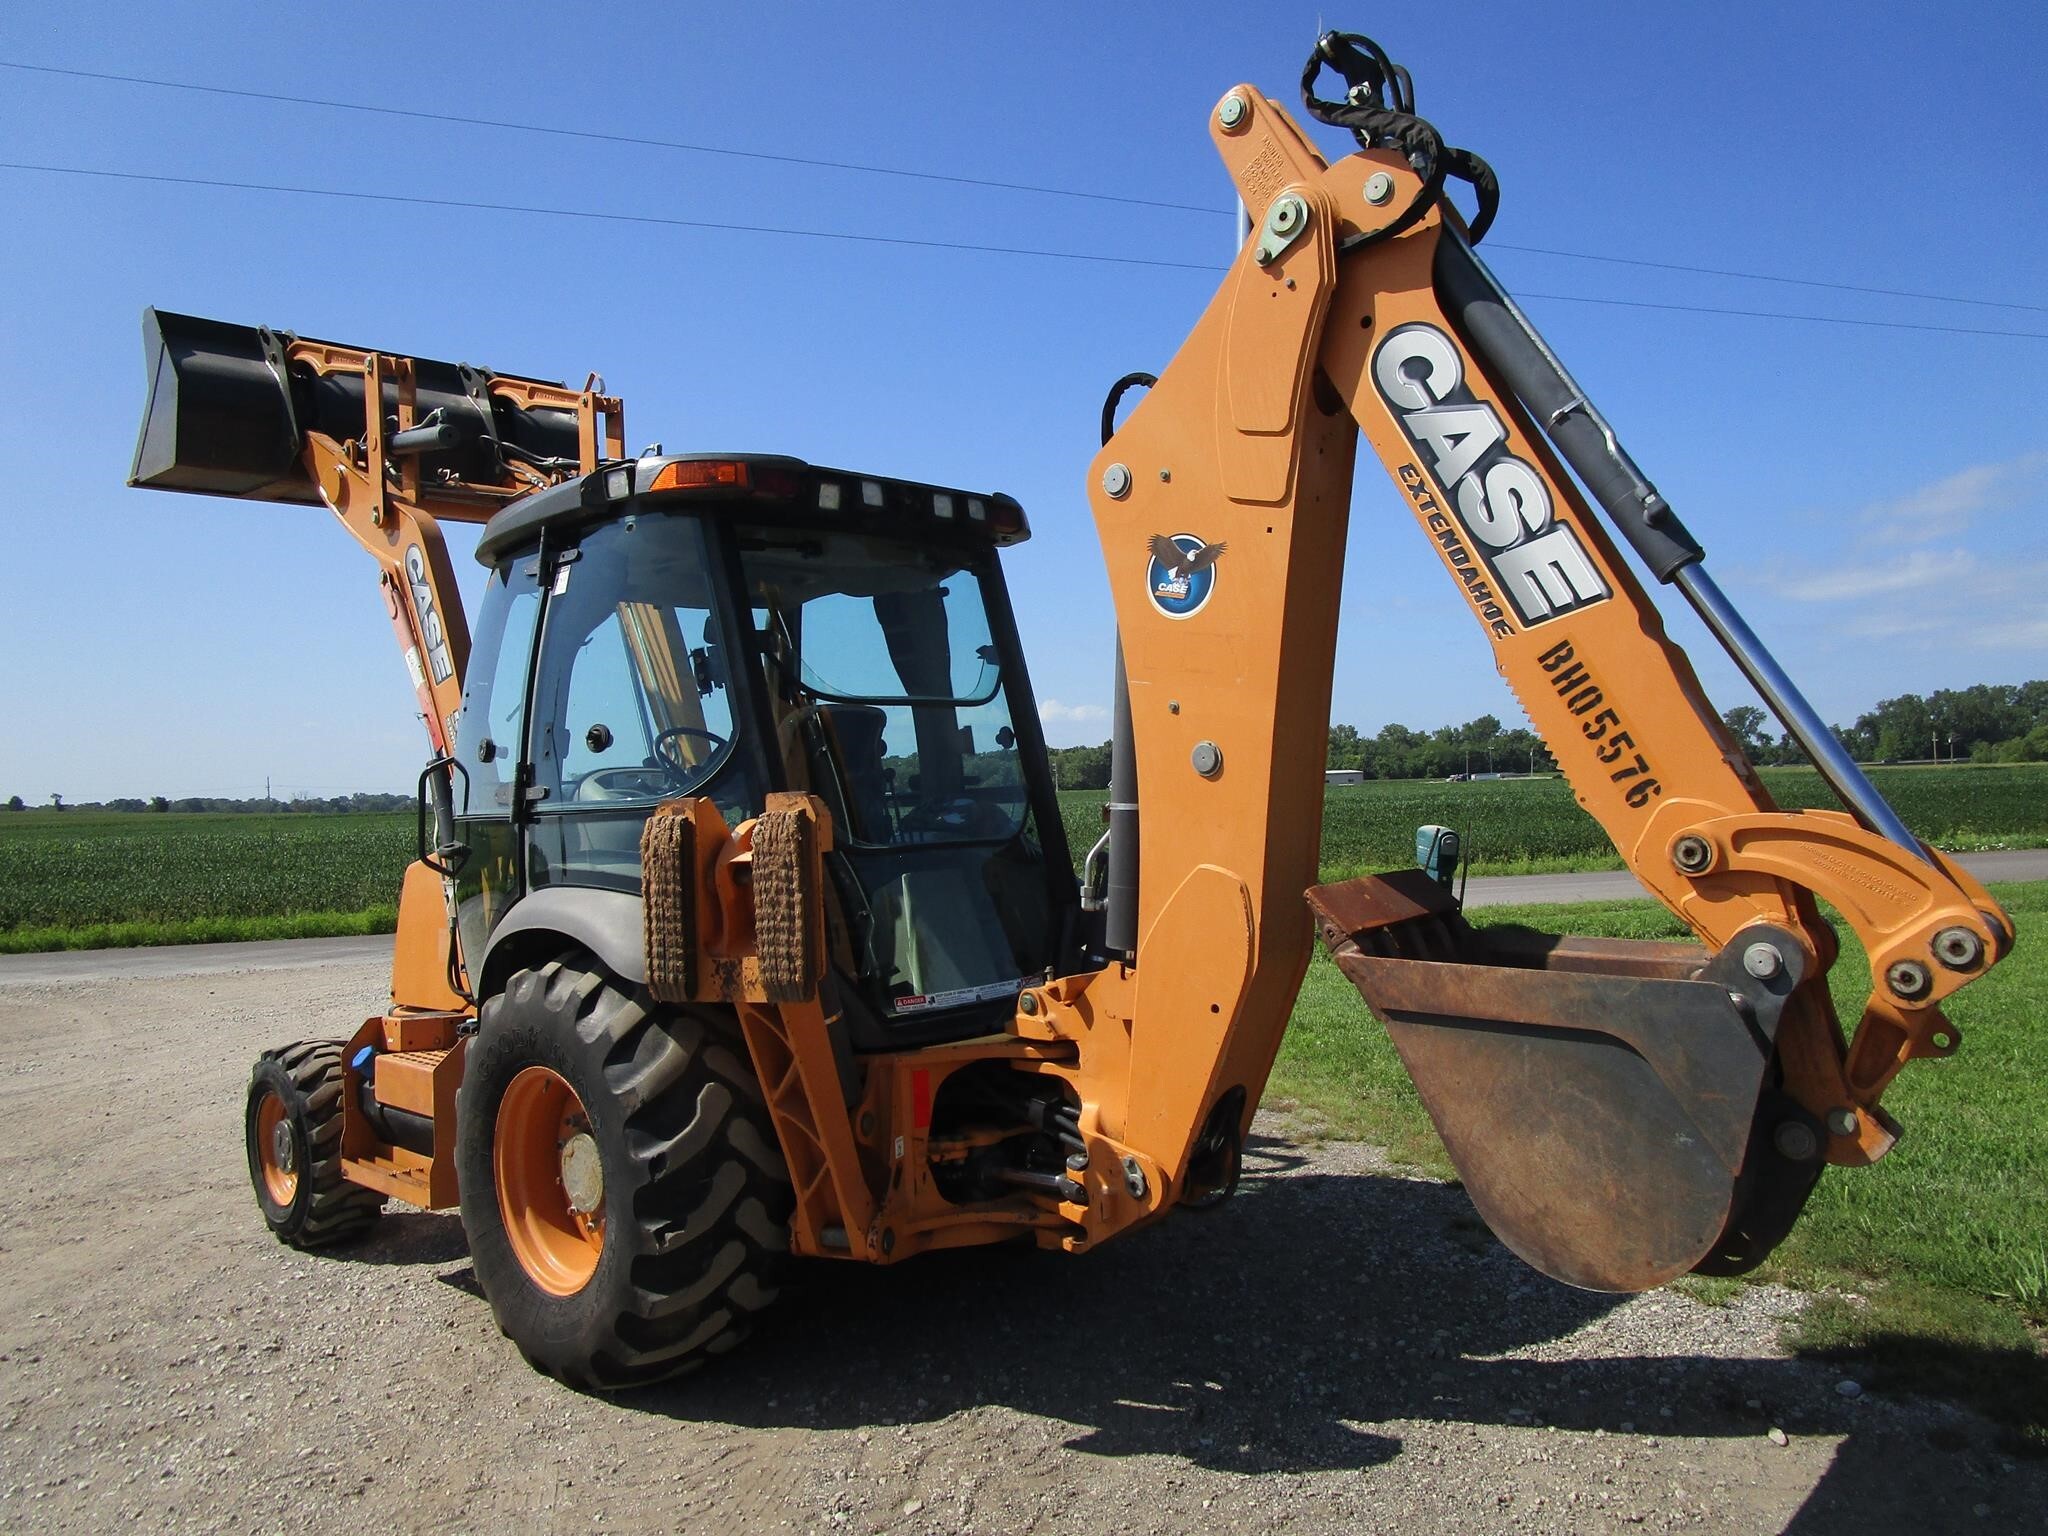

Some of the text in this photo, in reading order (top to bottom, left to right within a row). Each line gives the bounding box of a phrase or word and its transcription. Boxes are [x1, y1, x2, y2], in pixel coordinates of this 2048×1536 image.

[1372, 324, 1609, 625] CASE
[1398, 462, 1515, 640] EXTENDAHOE
[406, 544, 452, 684] CASE
[1158, 582, 1188, 594] CASE
[1537, 639, 1662, 809] BH05576
[903, 997, 926, 1006] DANGER
